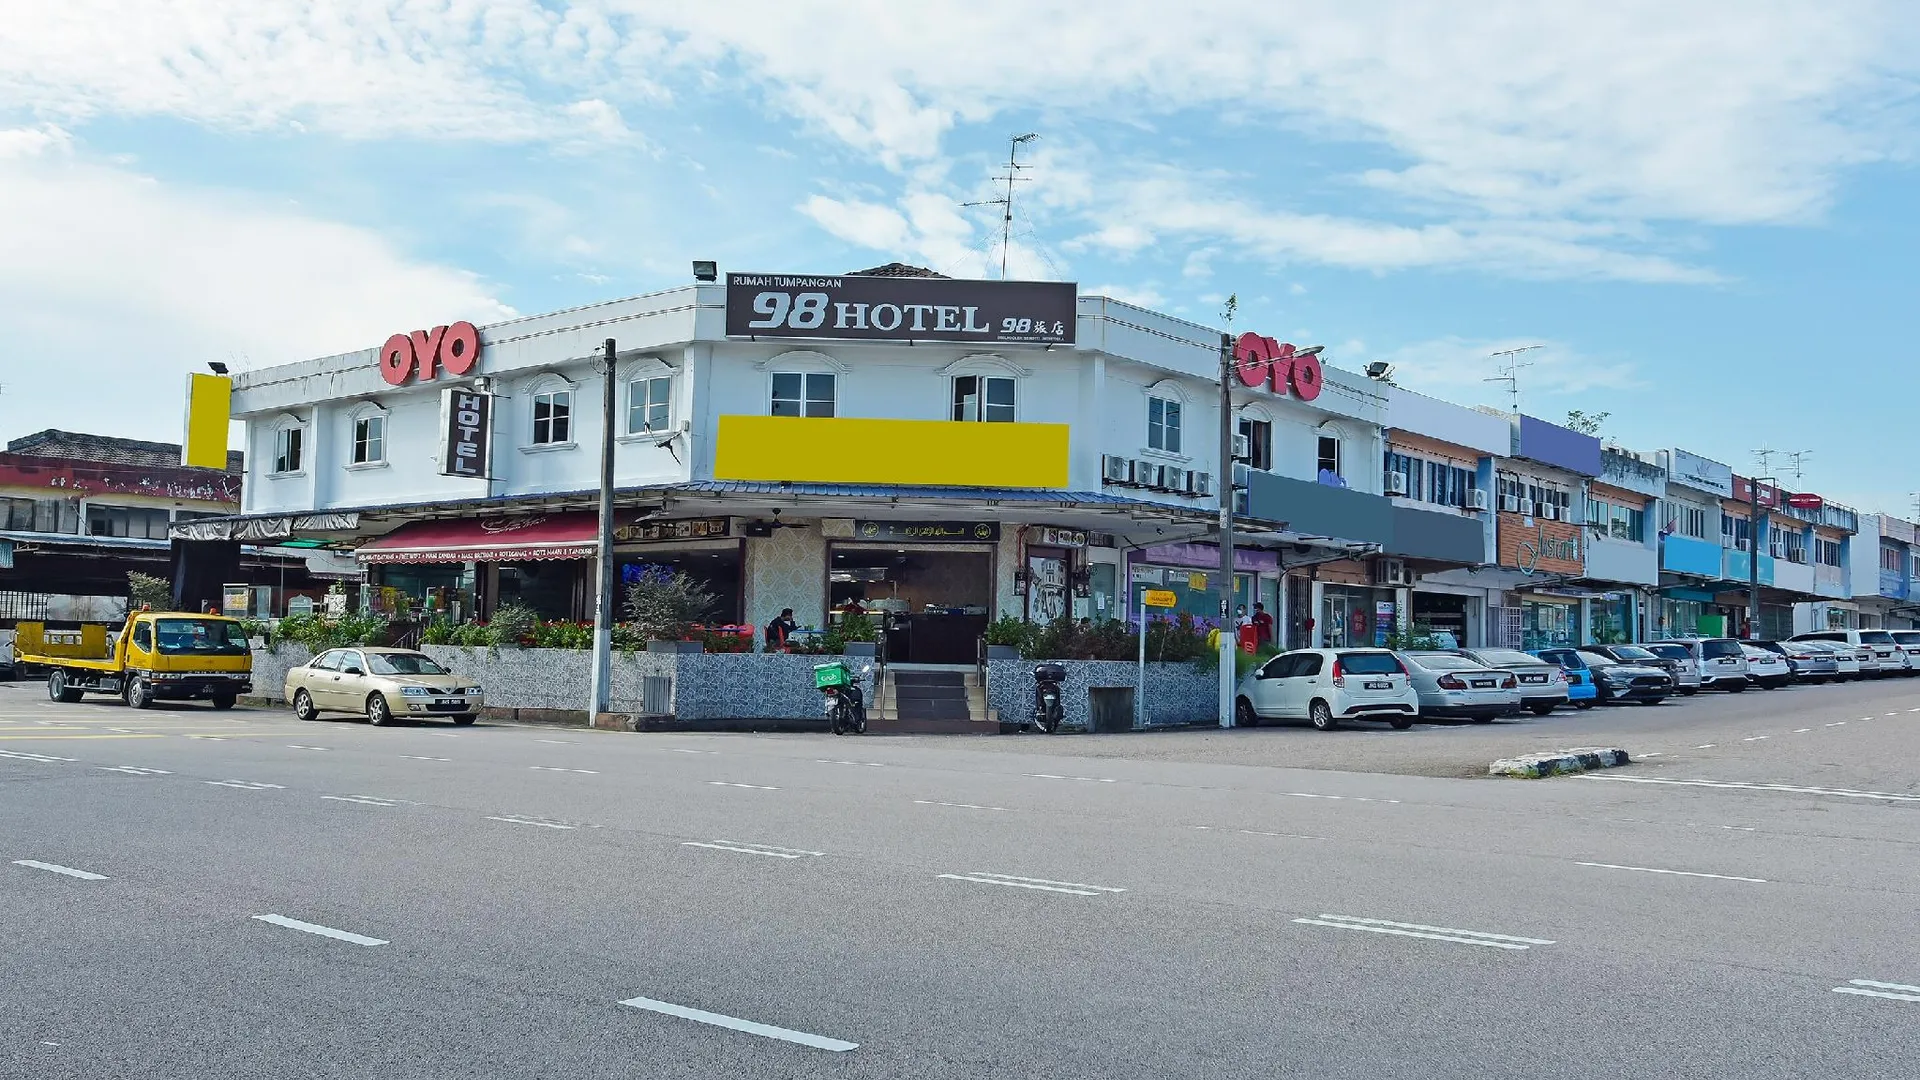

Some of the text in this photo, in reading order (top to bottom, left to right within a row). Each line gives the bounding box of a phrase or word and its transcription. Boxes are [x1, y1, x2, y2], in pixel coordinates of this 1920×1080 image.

[733, 276, 842, 288] RUMAH TUMPANGAN
[748, 291, 990, 333] 98 HOTEL
[1000, 317, 1032, 333] 98
[380, 320, 480, 386] OYO
[1232, 332, 1323, 402] OYO
[455, 394, 481, 474] HOTEL
